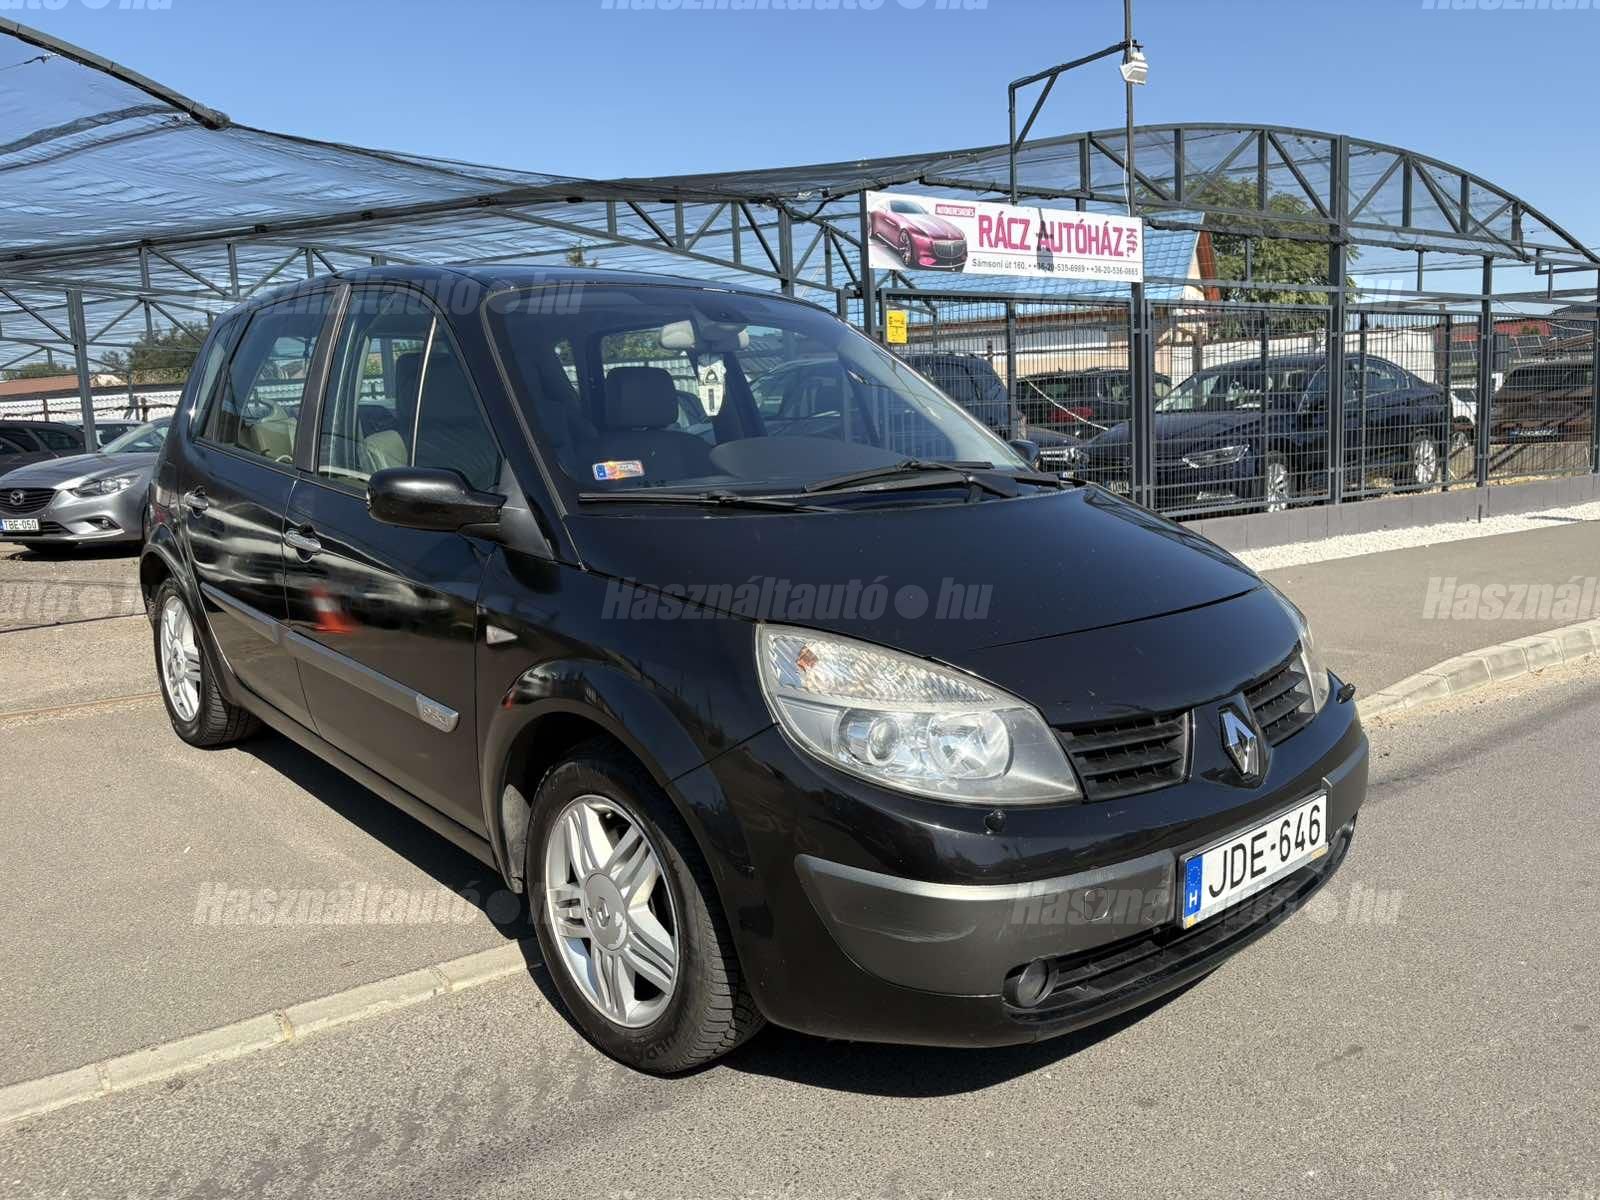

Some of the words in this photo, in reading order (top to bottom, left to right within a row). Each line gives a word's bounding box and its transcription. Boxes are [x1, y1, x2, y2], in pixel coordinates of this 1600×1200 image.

[978, 211, 1031, 250] RÁCZ
[1037, 218, 1124, 257] AUTÓHÁZ
[1208, 804, 1321, 898] JDE-646
[1189, 889, 1198, 908] H
